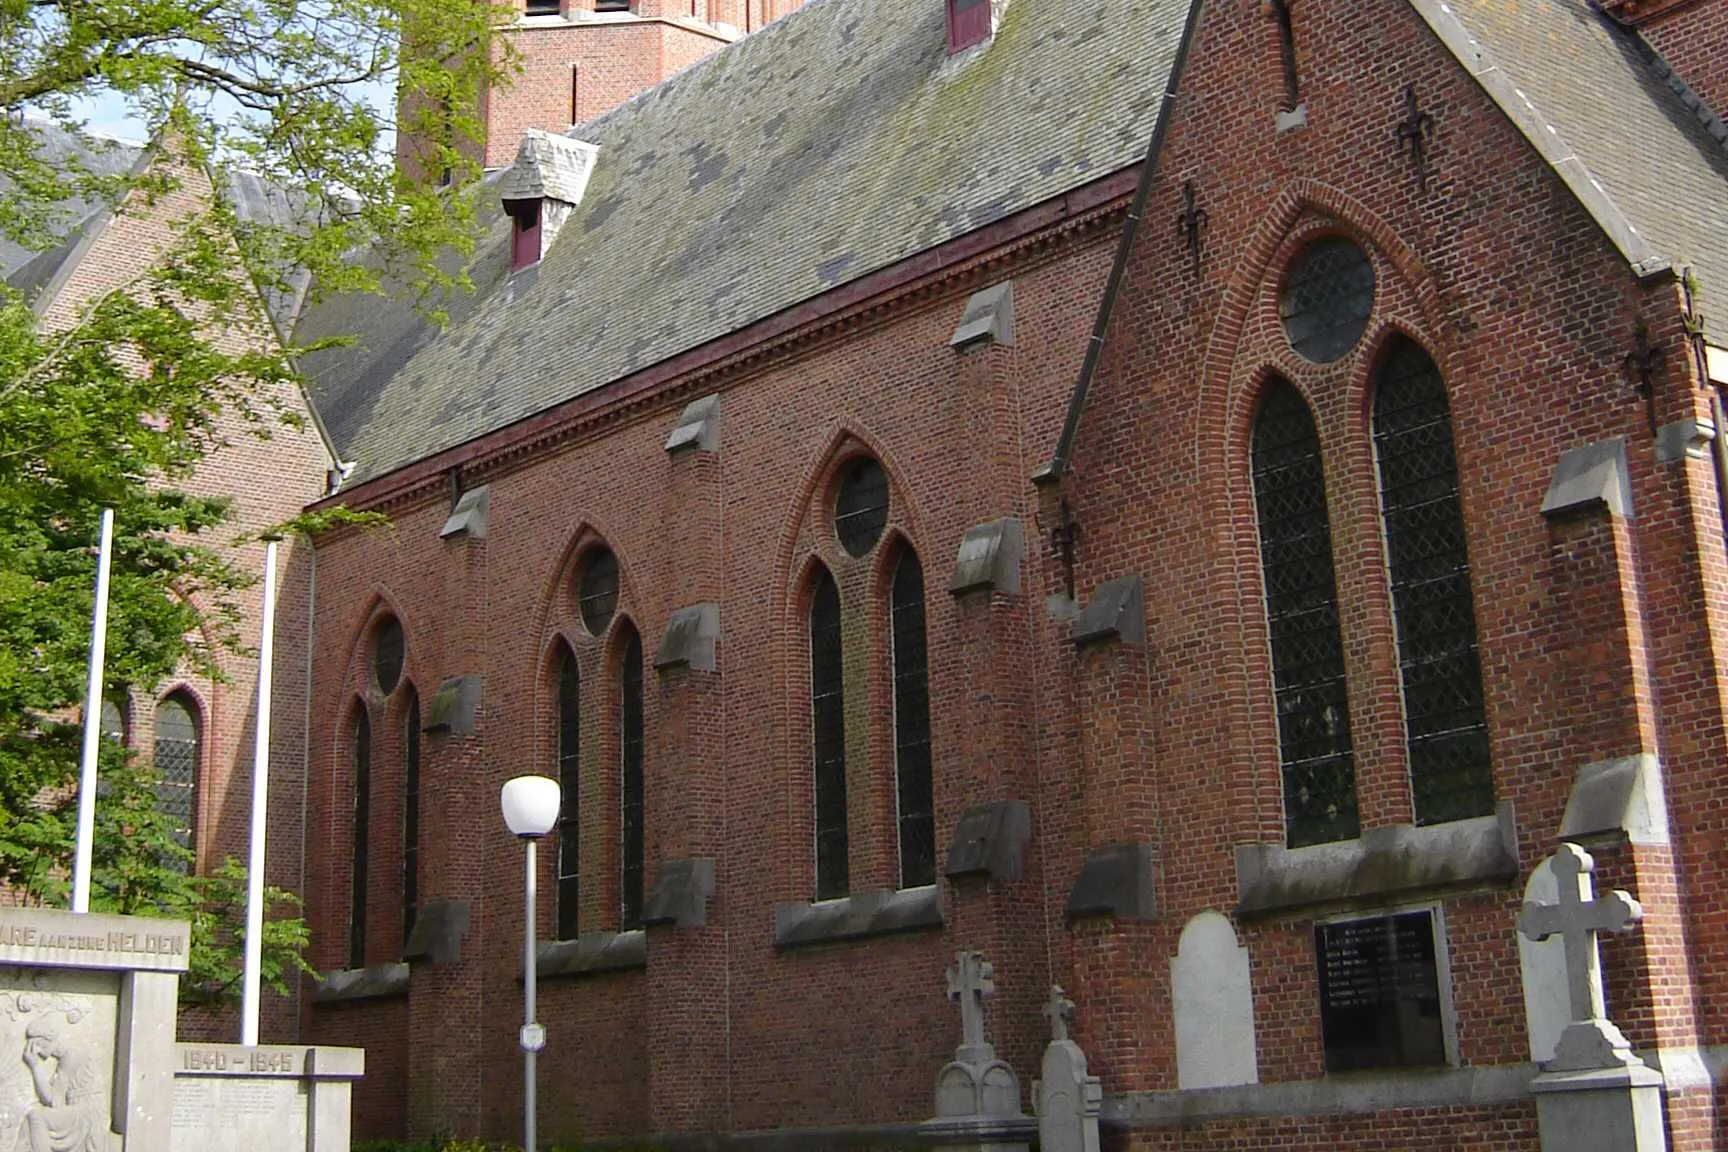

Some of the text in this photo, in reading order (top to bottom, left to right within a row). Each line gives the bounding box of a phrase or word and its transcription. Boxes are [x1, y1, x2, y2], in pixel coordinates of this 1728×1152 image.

[107, 931, 184, 956] HELDEN
[184, 1049, 227, 1070] 1940
[250, 1051, 293, 1072] 1945
